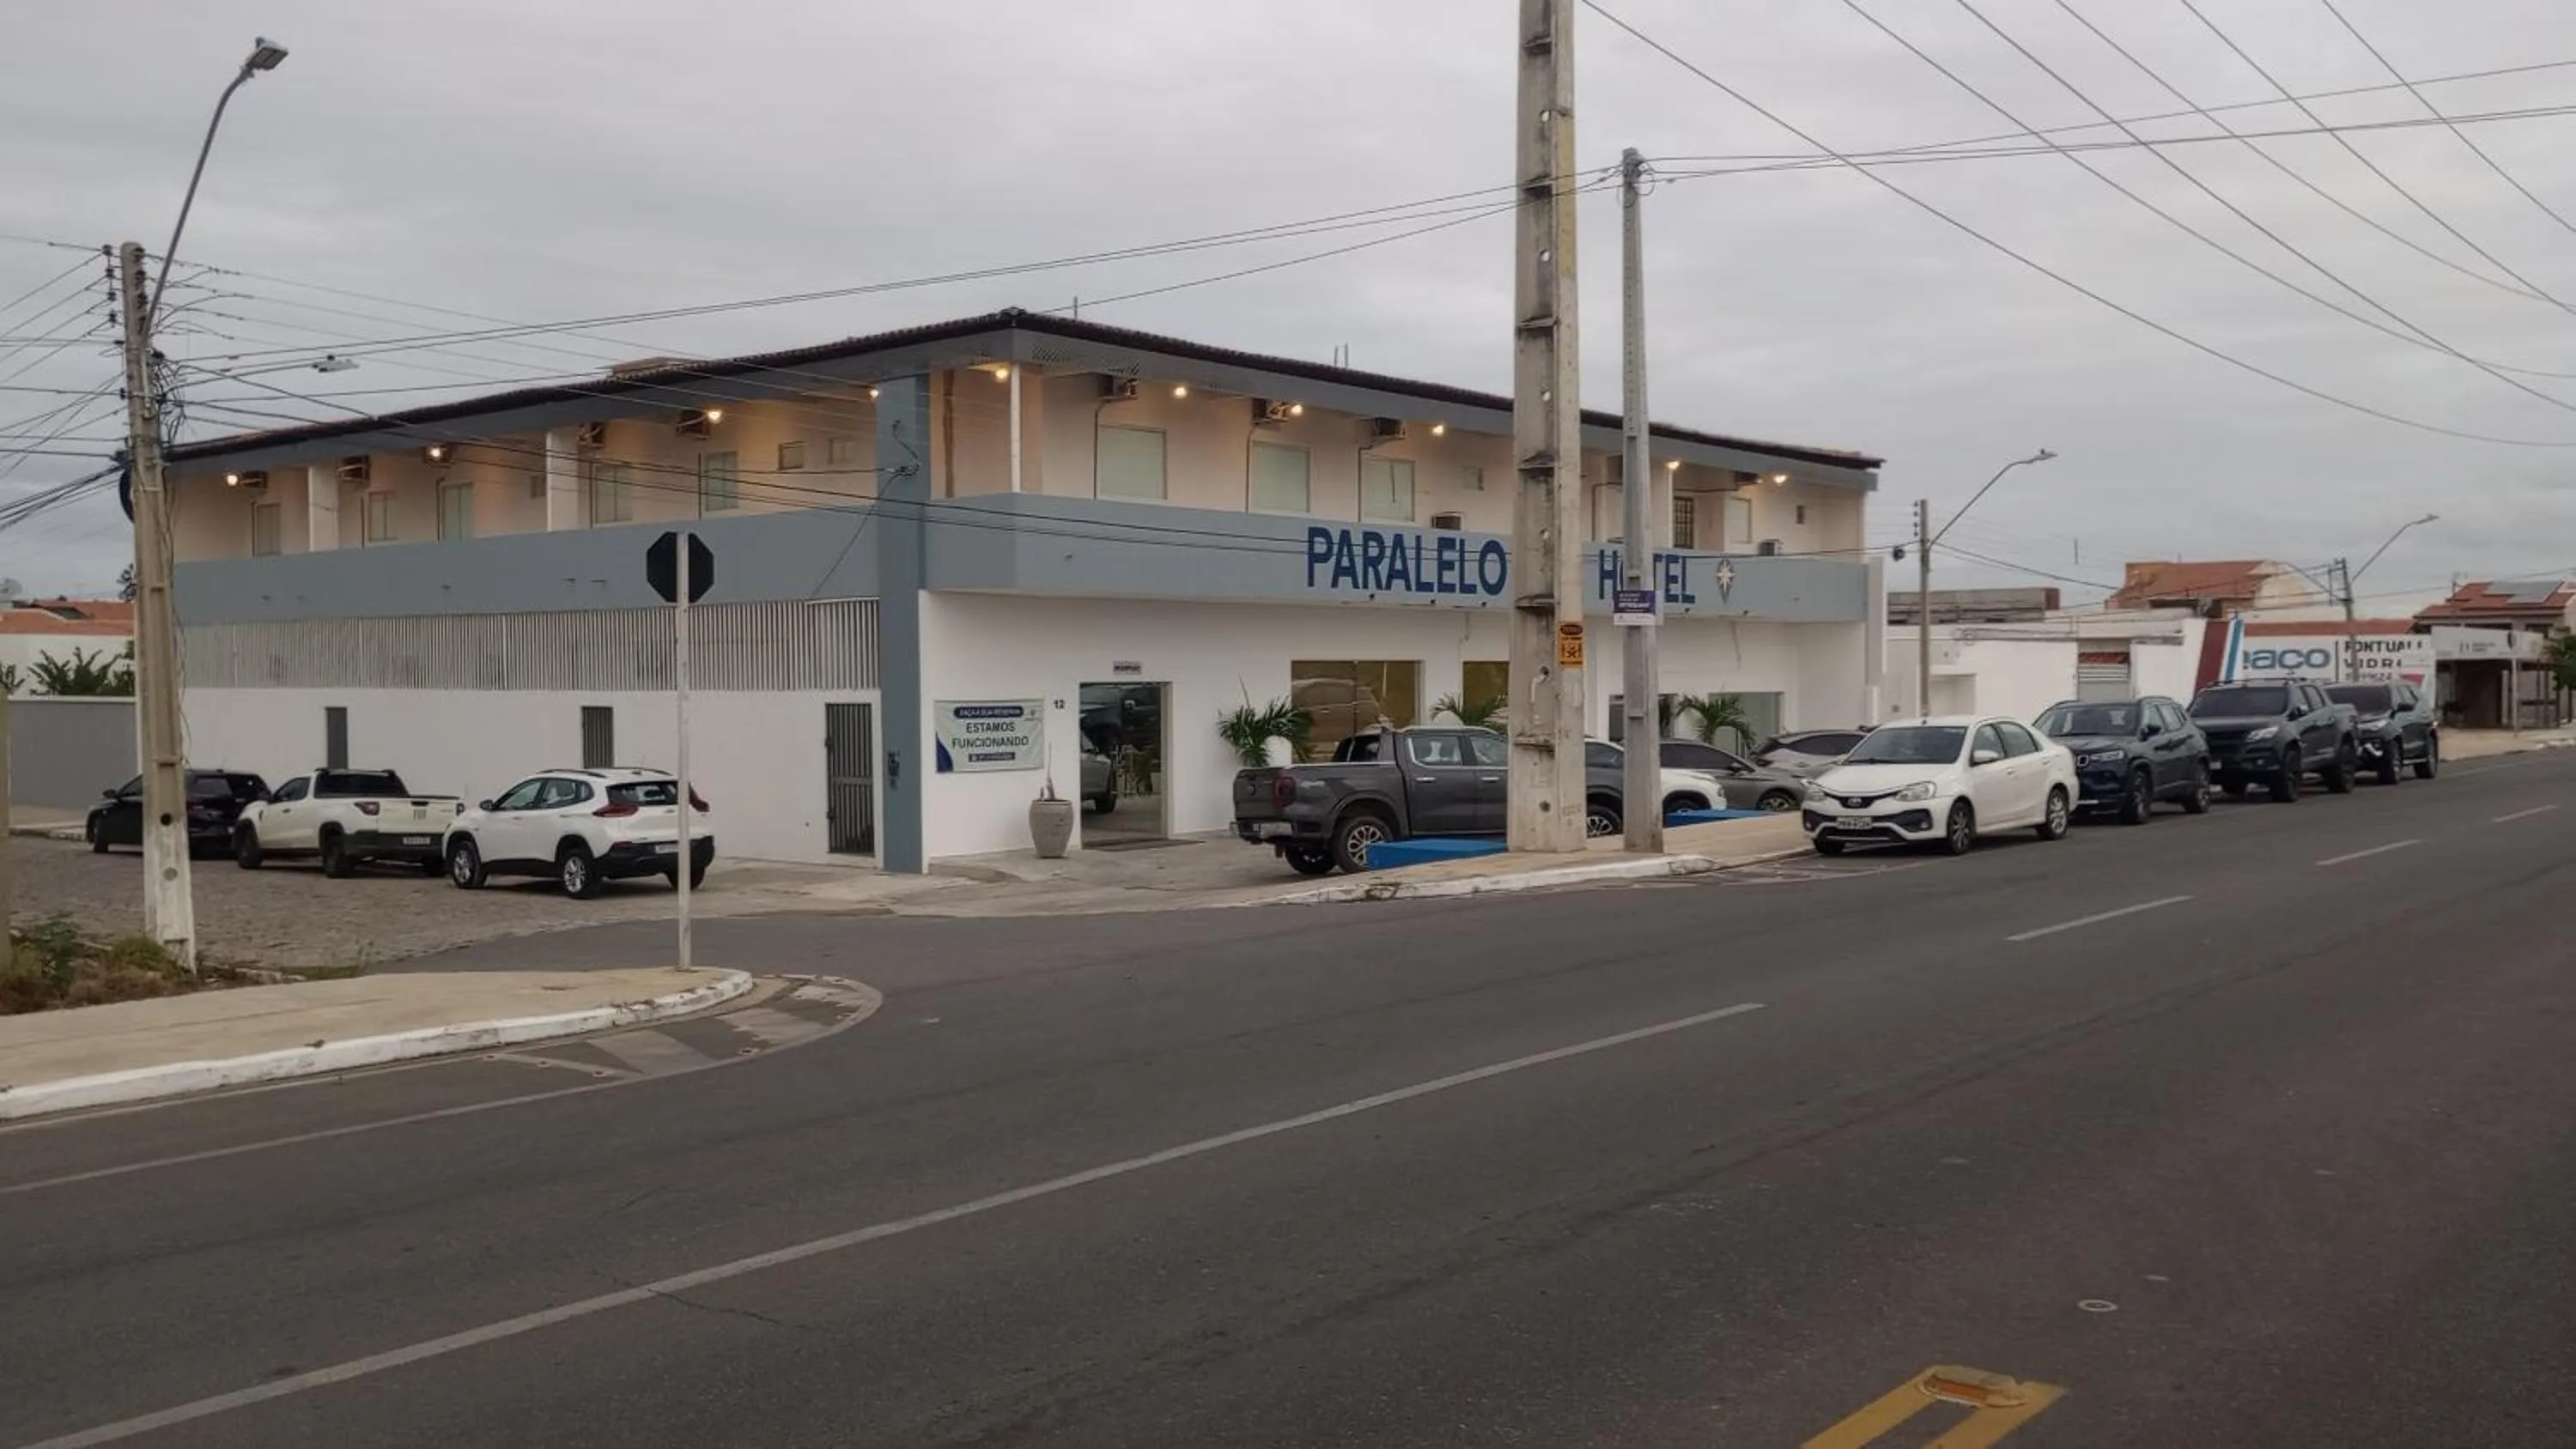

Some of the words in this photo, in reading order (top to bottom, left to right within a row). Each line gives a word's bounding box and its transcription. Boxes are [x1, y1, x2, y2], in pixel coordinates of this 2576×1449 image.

[1308, 526, 1508, 596] PARALELO
[1598, 548, 1696, 604] HTEL
[966, 722, 1016, 733] ESTAMOS
[951, 736, 1030, 749] FUNCIONANDO
